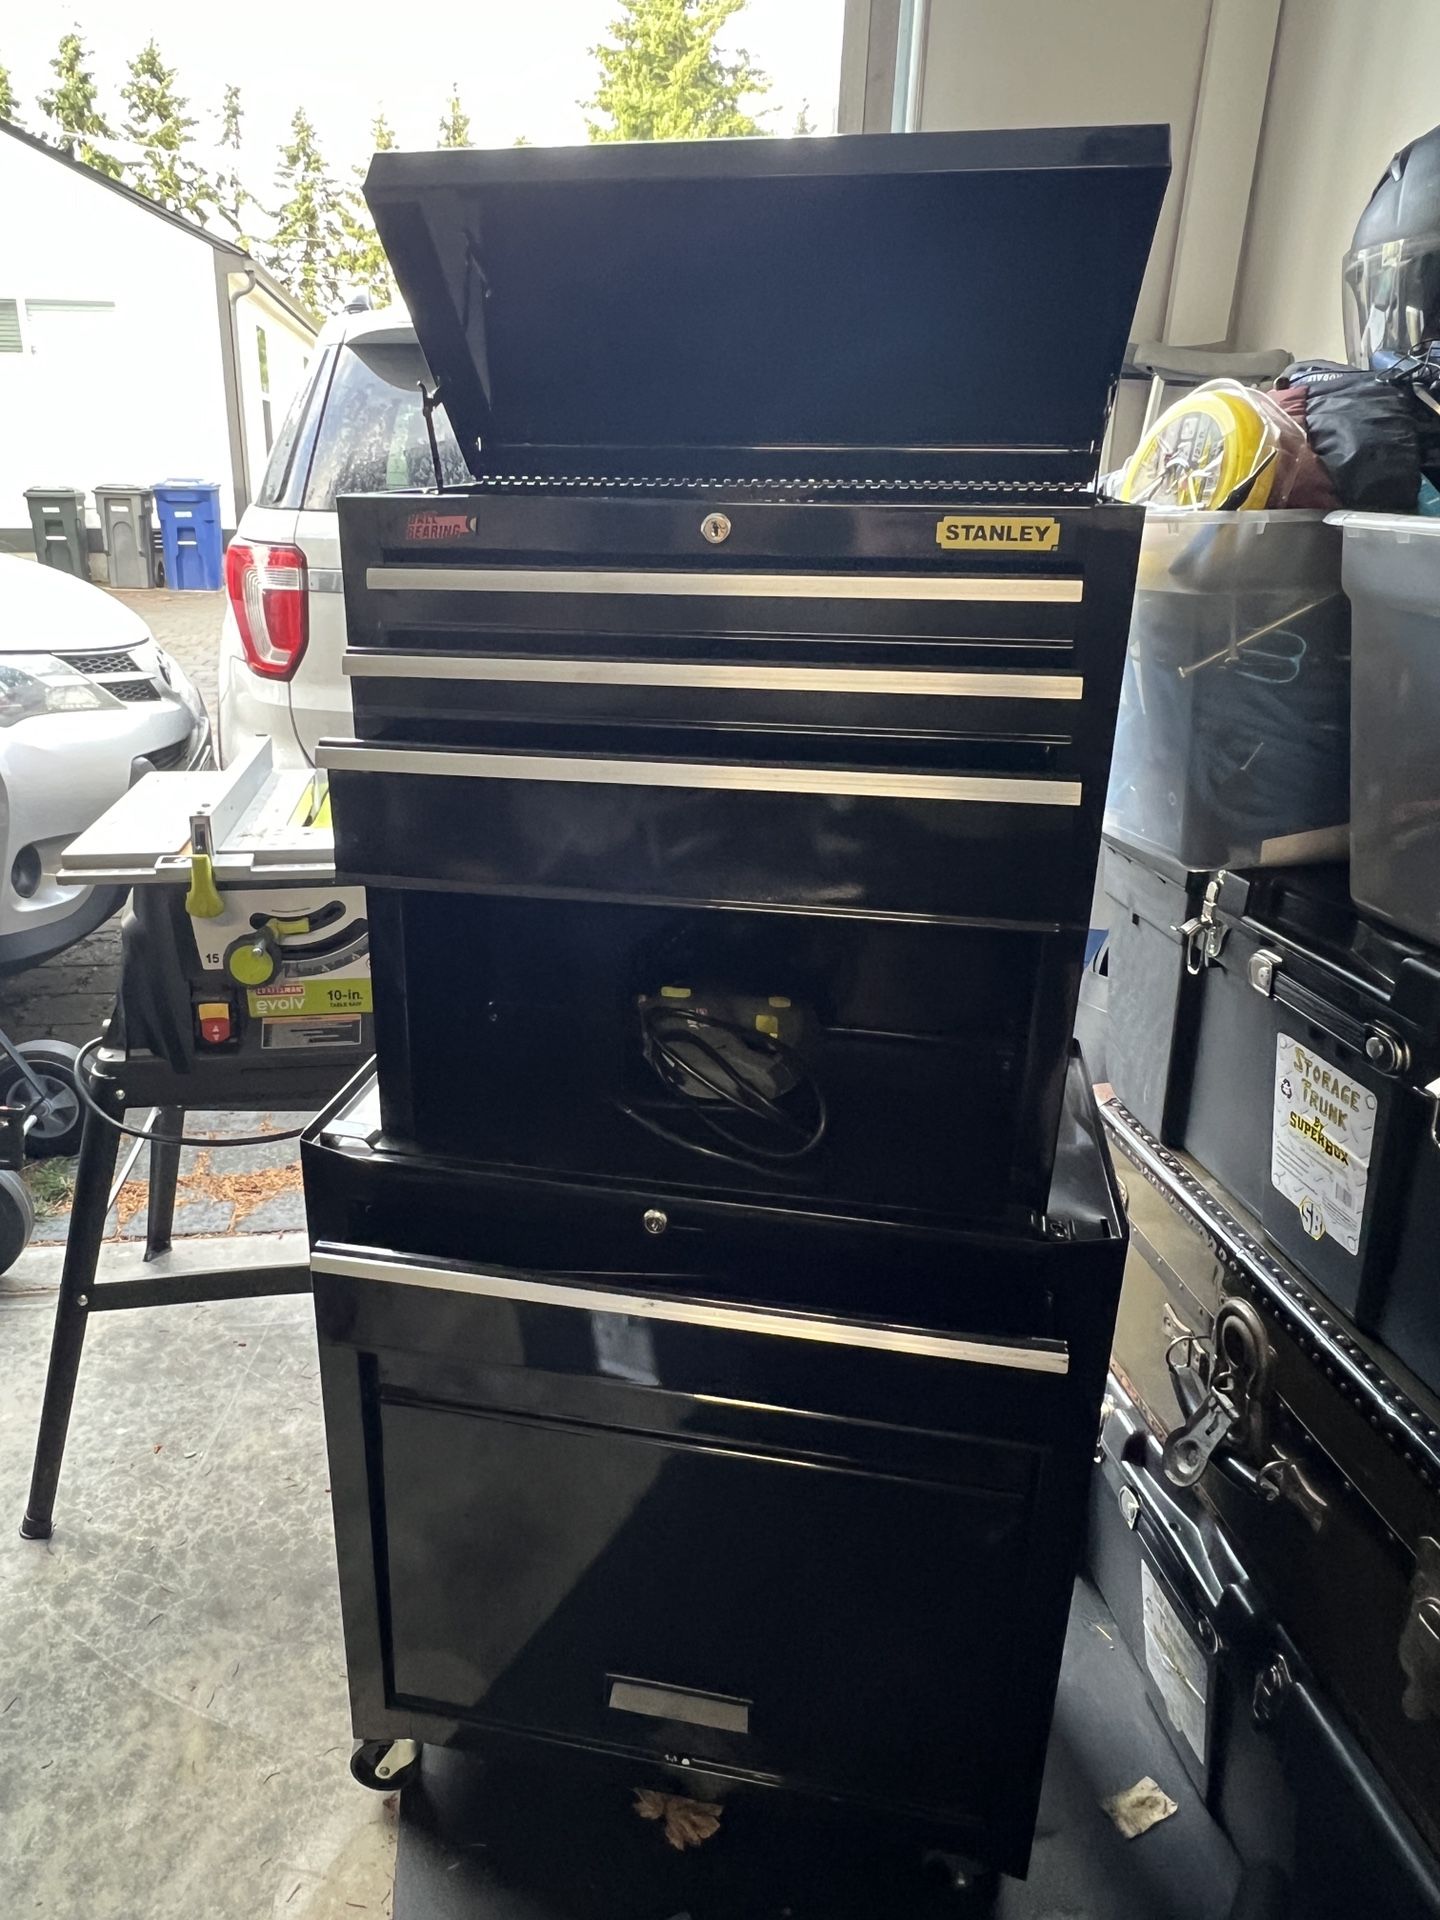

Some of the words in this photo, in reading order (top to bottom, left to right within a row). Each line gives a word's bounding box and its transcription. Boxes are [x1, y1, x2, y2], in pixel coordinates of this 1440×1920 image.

[407, 524, 461, 539] BEARING
[945, 524, 1051, 542] STANLEY
[206, 954, 219, 964] 15
[327, 989, 364, 1001] 10-in.
[256, 997, 305, 1011] evolv
[1294, 1046, 1361, 1113] STORAGE
[1302, 1078, 1348, 1132] TRUNK
[1314, 1116, 1324, 1131] BY
[1290, 1111, 1349, 1166] SUPERBOX
[1301, 1202, 1323, 1235] SB
